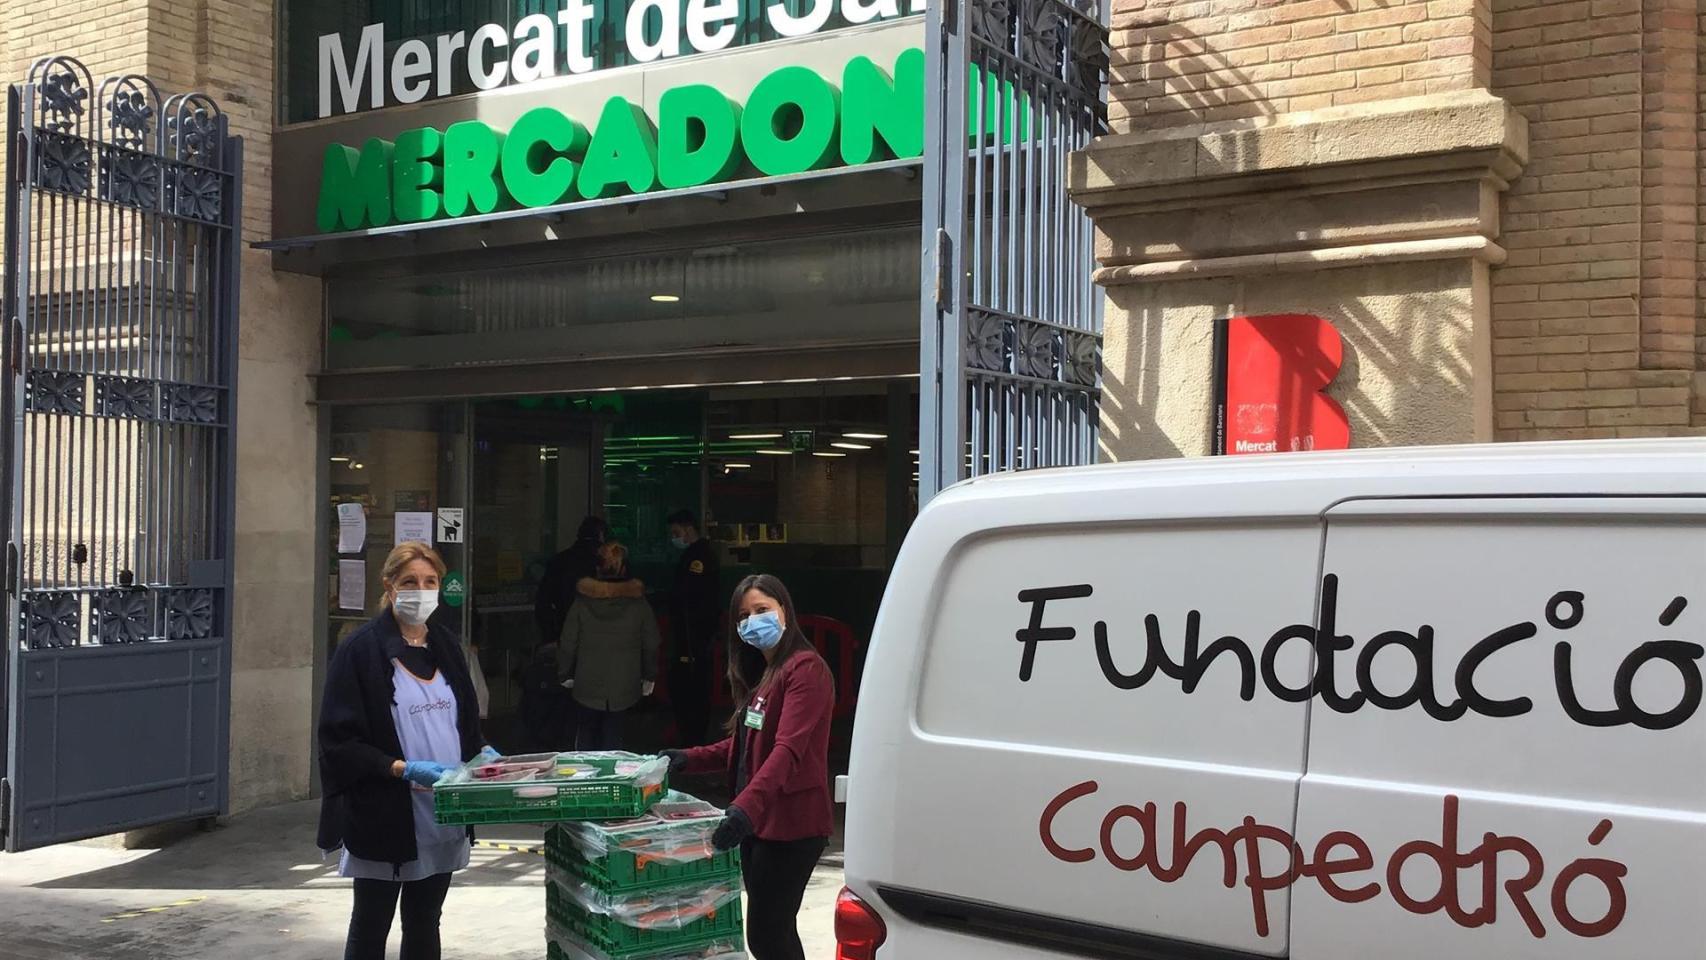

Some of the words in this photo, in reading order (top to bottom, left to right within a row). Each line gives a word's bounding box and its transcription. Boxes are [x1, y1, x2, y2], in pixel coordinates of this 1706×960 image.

[318, 0, 594, 118] Mercat
[1235, 440, 1277, 453] Mercat
[1016, 574, 1705, 731] Fundació
